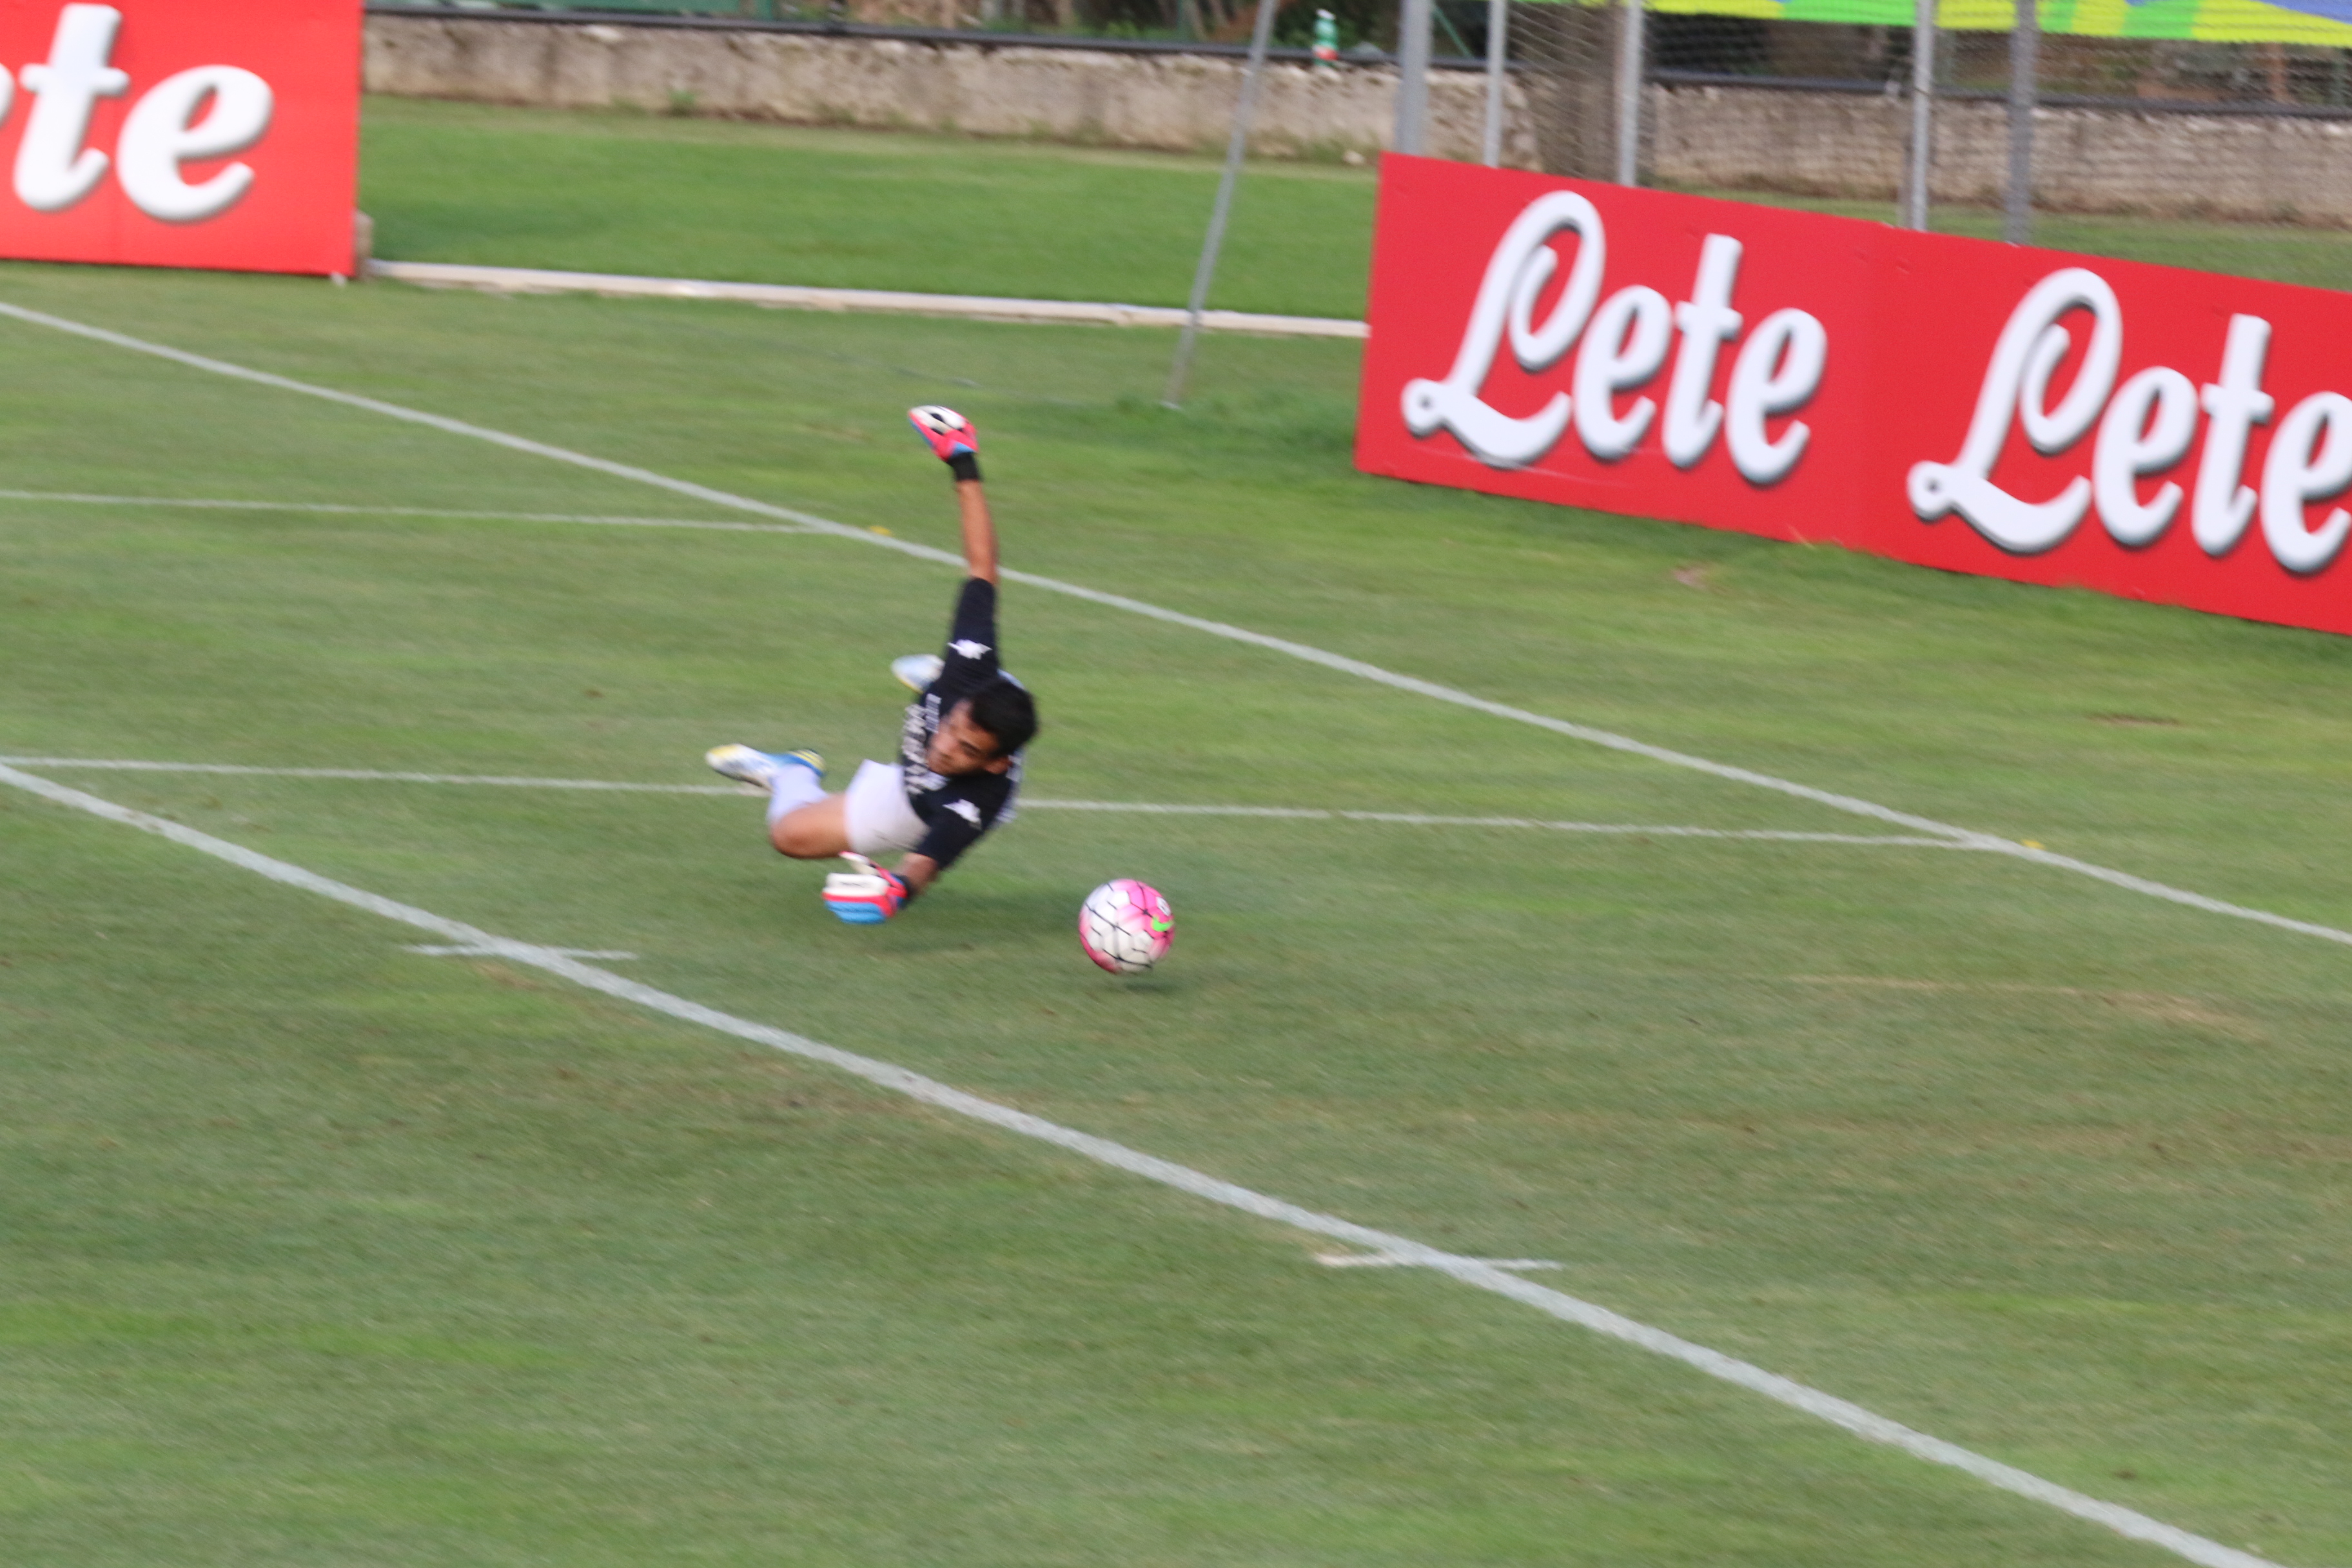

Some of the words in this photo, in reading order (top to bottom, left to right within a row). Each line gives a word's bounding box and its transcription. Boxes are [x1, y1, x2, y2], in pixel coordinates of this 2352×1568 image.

[0, 3, 275, 224] te
[1400, 190, 1827, 487] Lete
[1906, 267, 2352, 577] Lete
